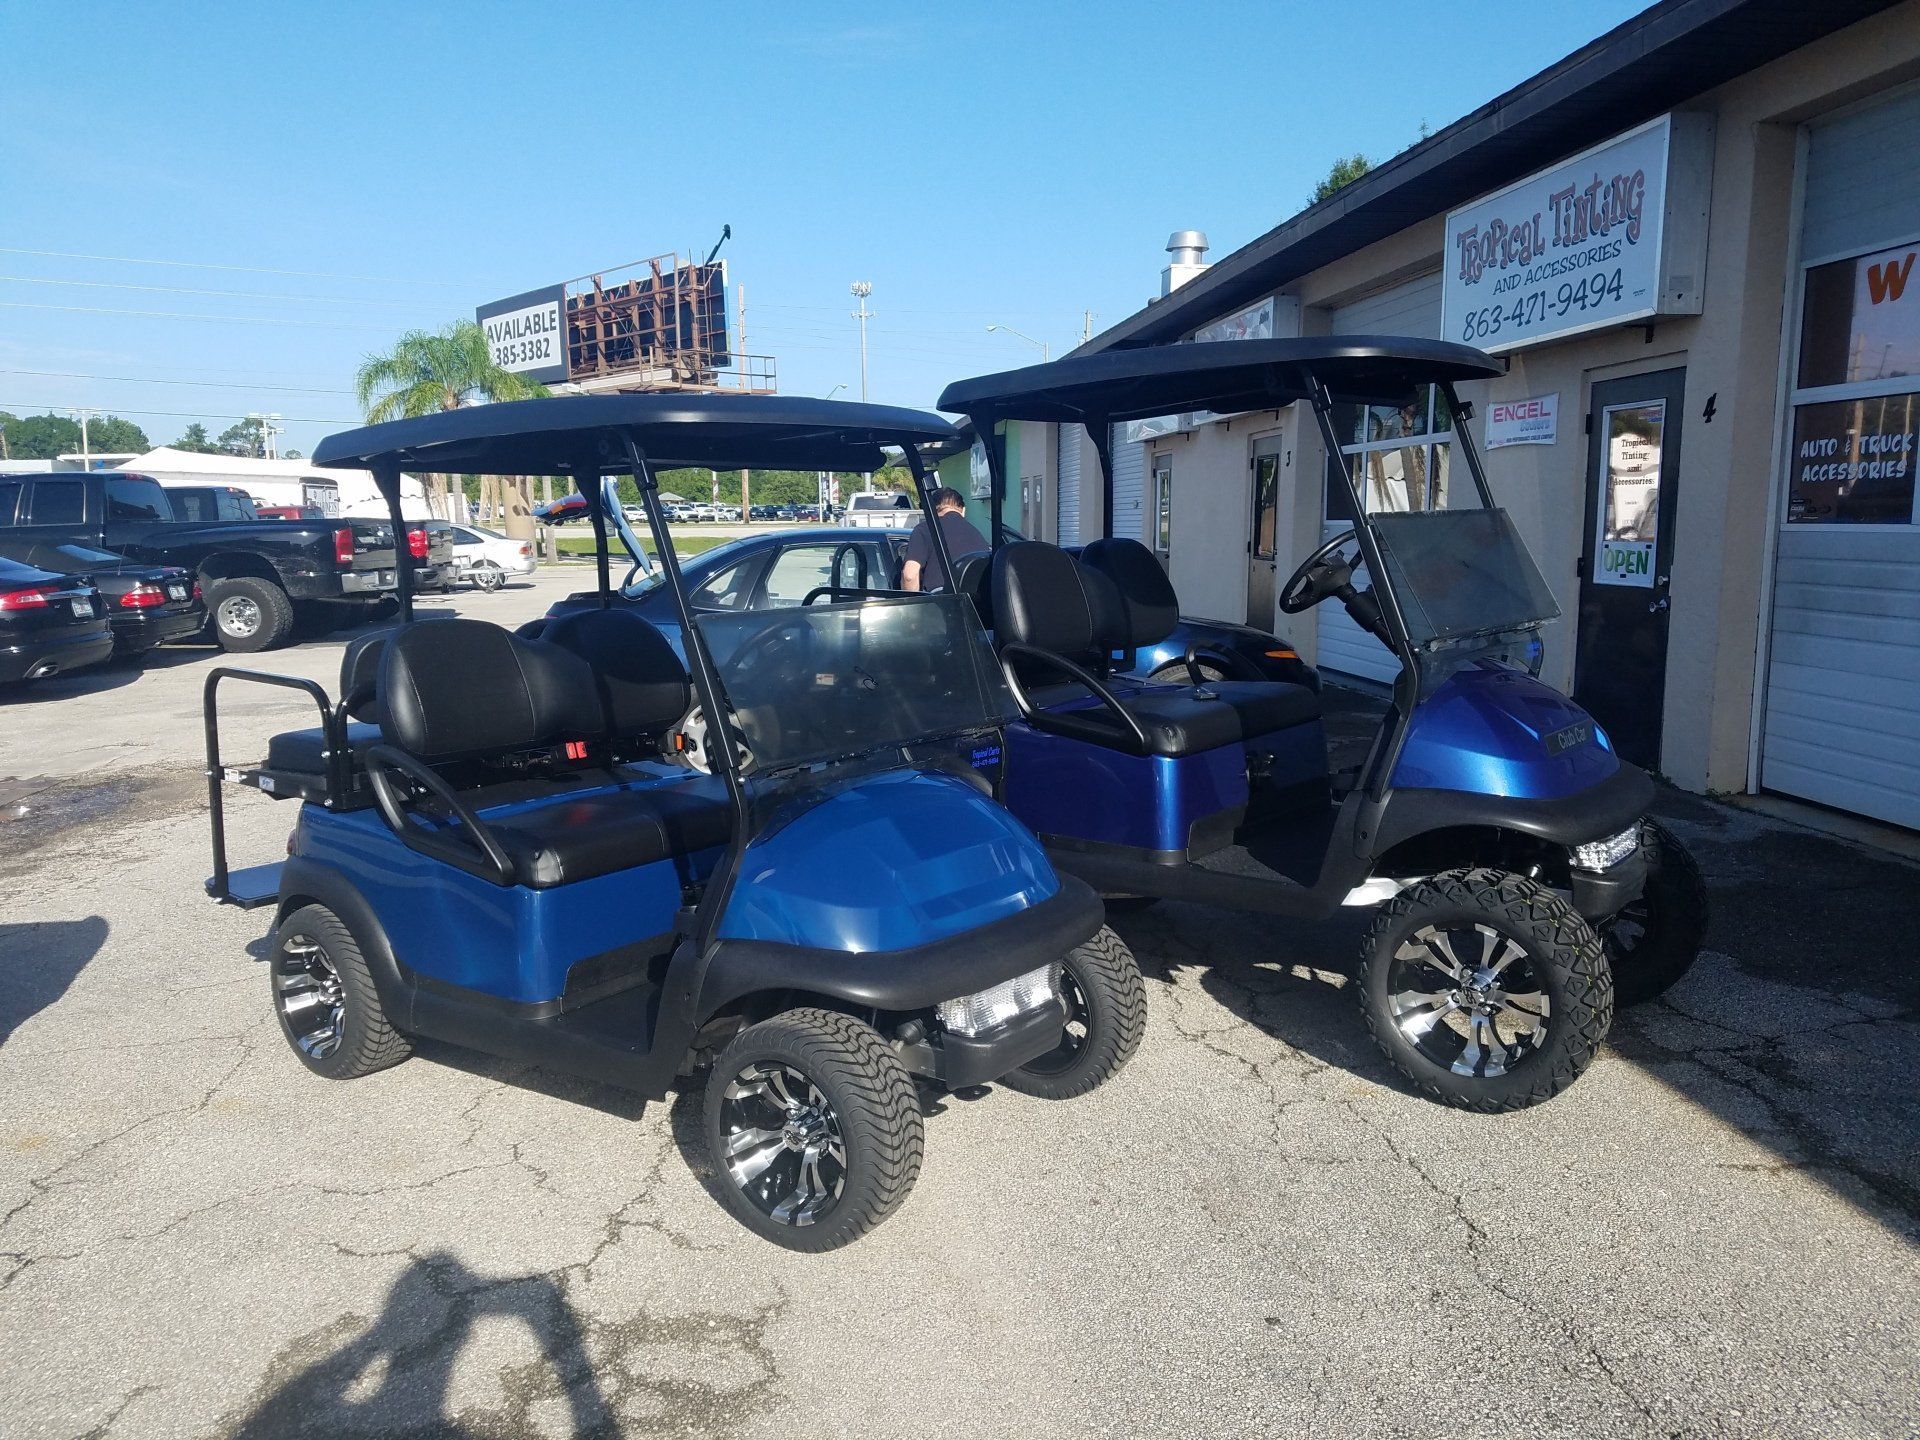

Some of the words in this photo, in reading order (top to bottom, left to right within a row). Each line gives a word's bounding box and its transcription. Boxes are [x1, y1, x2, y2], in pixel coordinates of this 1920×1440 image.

[1493, 272, 1521, 296] AND
[1524, 239, 1622, 285] ACCESSORIES
[1867, 252, 1917, 305] W
[1463, 267, 1623, 342] 863-471-9494
[486, 309, 557, 344] AVAILABLE
[496, 337, 551, 366] 385-3382
[1493, 401, 1551, 424] ENGEL
[1703, 393, 1717, 423] 4
[1622, 437, 1652, 448] Tropical
[1800, 438, 1838, 458] AUTO
[1859, 432, 1913, 454] TRUCK
[1801, 460, 1907, 483] ACCESSORIES
[1603, 549, 1650, 575] OPEN
